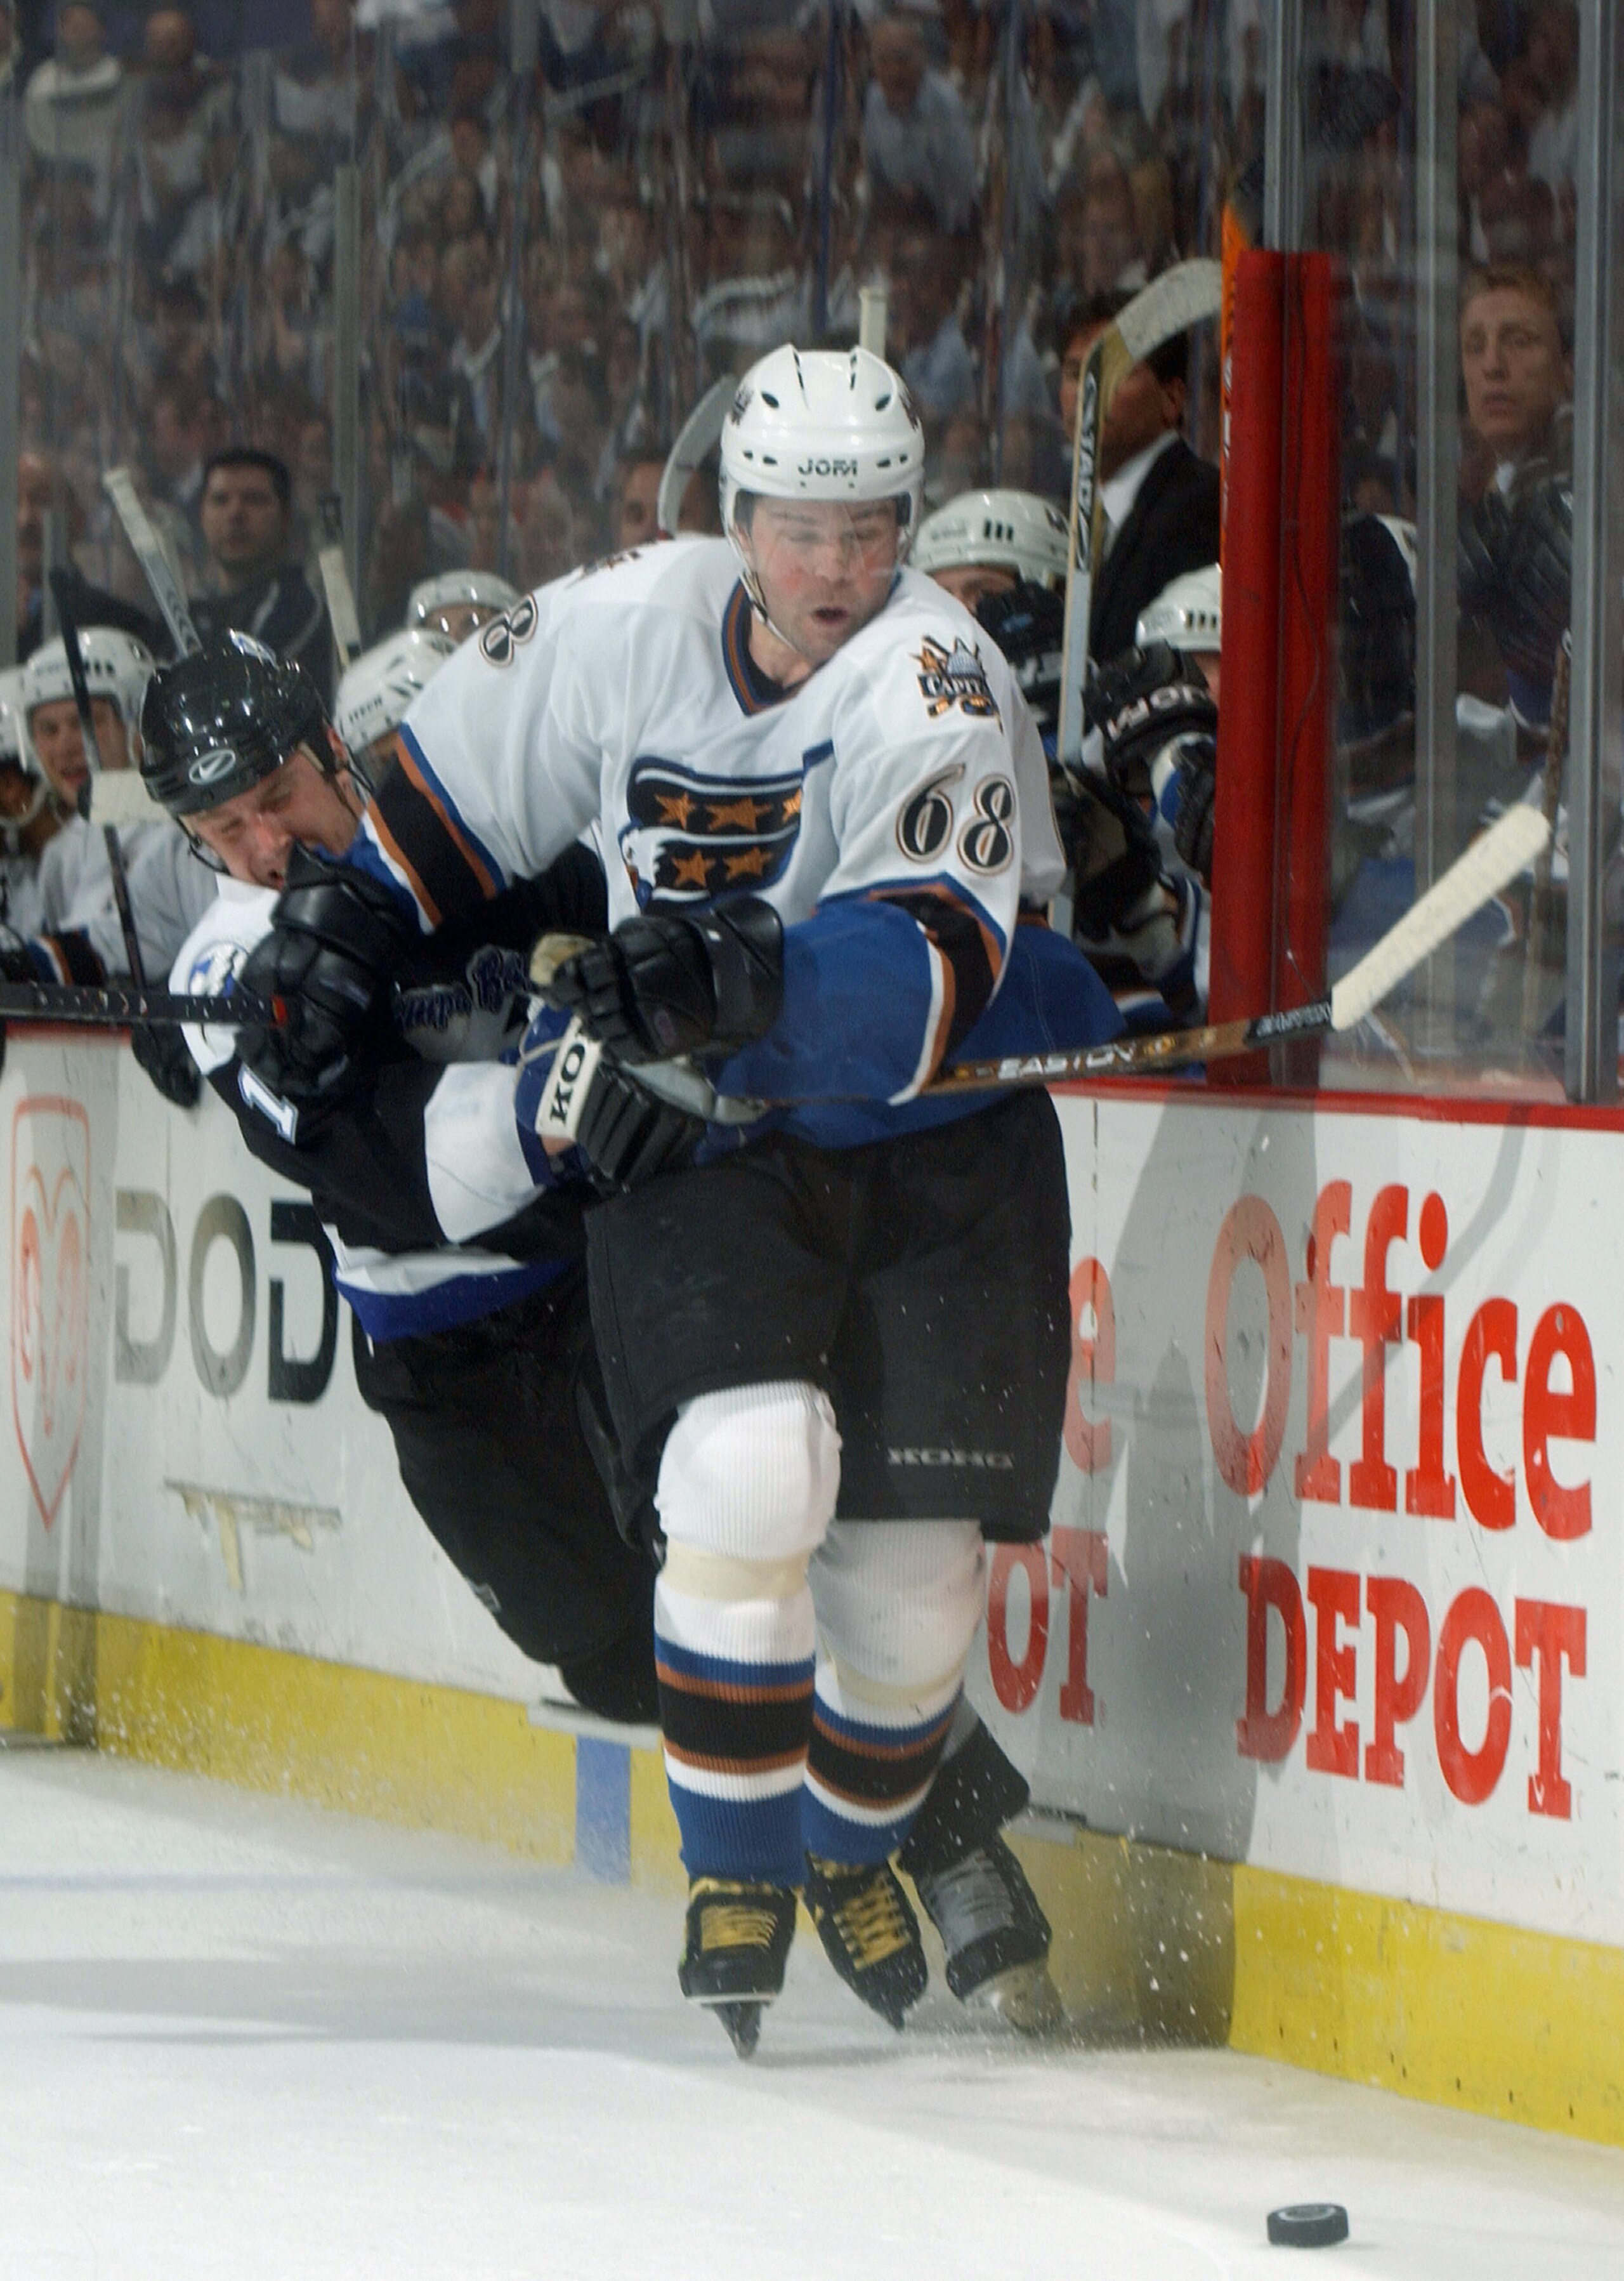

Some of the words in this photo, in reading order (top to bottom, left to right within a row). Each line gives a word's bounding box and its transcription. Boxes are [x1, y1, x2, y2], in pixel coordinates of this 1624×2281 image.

[895, 761, 1015, 878] 68
[551, 1041, 586, 1126] KO
[1205, 1180, 1597, 1541] Office
[1236, 1551, 1587, 1821] DEPOT
